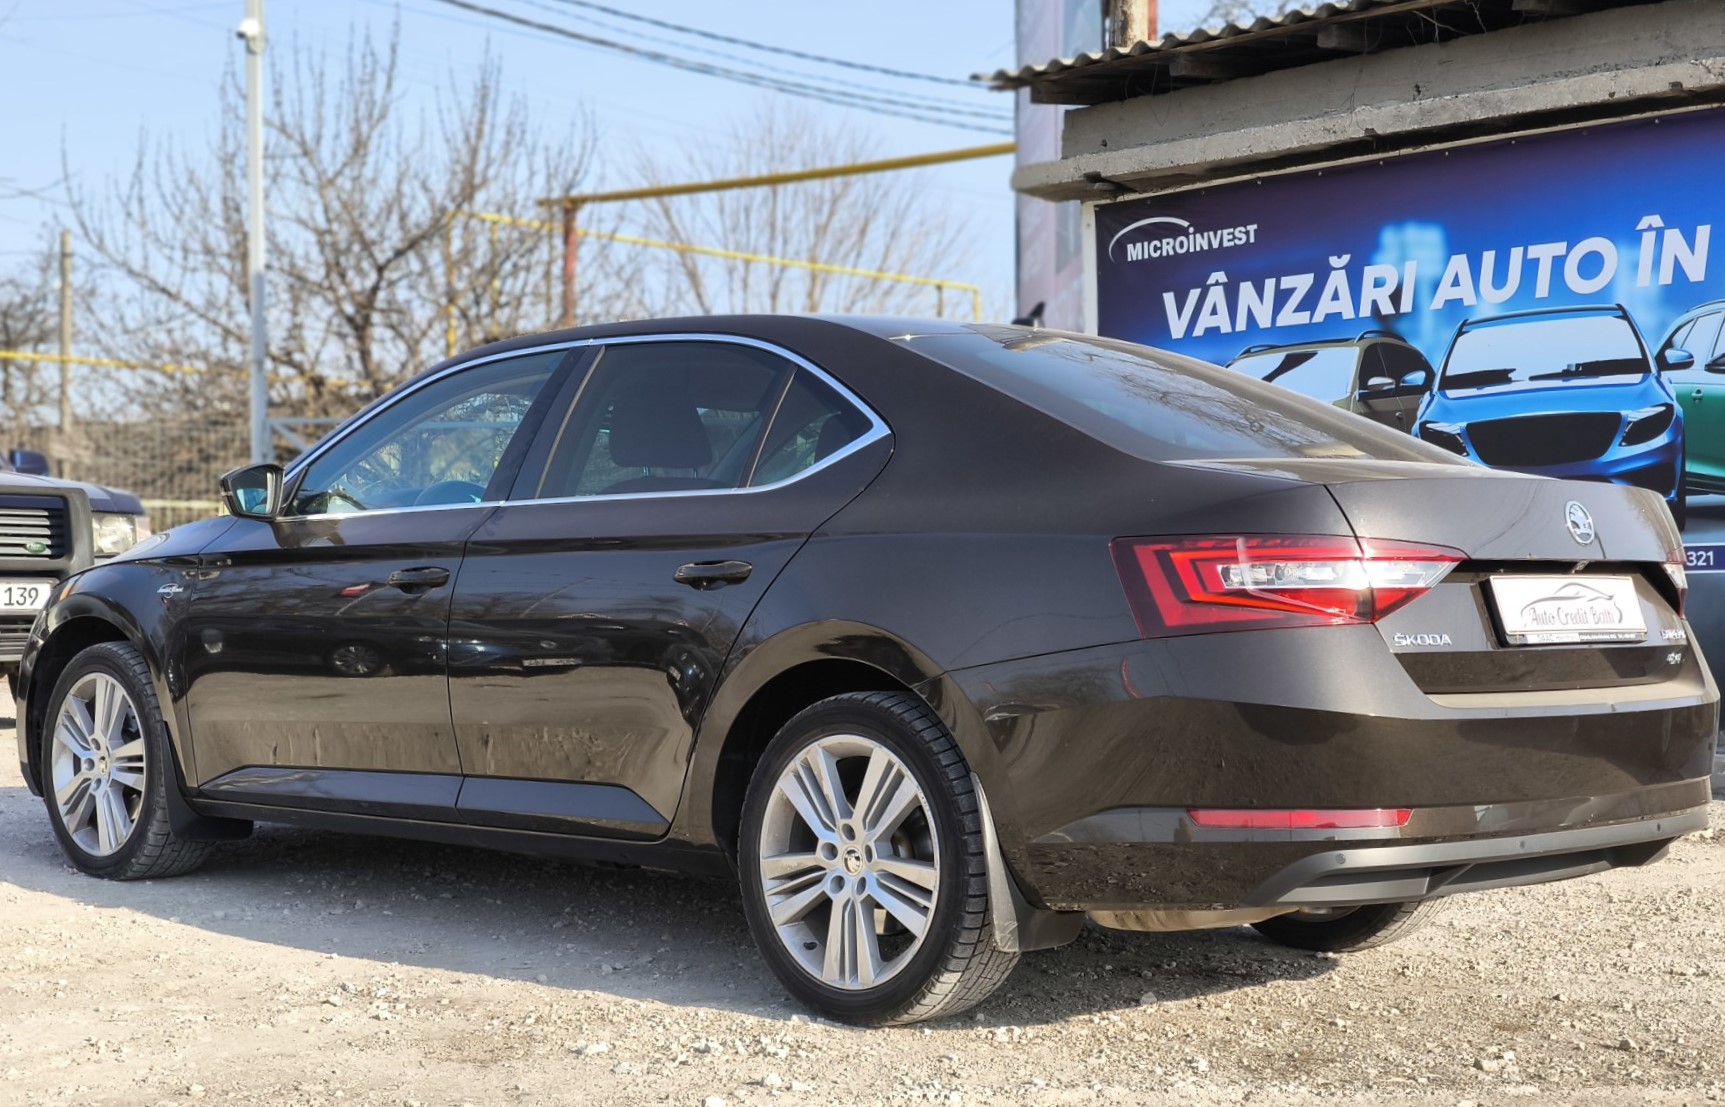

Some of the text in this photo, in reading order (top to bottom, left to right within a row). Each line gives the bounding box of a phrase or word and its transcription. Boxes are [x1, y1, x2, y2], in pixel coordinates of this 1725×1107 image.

[1162, 215, 1711, 340] VÂNZĂRI AUTO ÎN
[1686, 550, 1714, 567] 321
[3, 586, 39, 606] 139
[1528, 606, 1555, 626] Auto
[1557, 606, 1589, 625] Credit
[1393, 632, 1452, 646] ŠKODA
